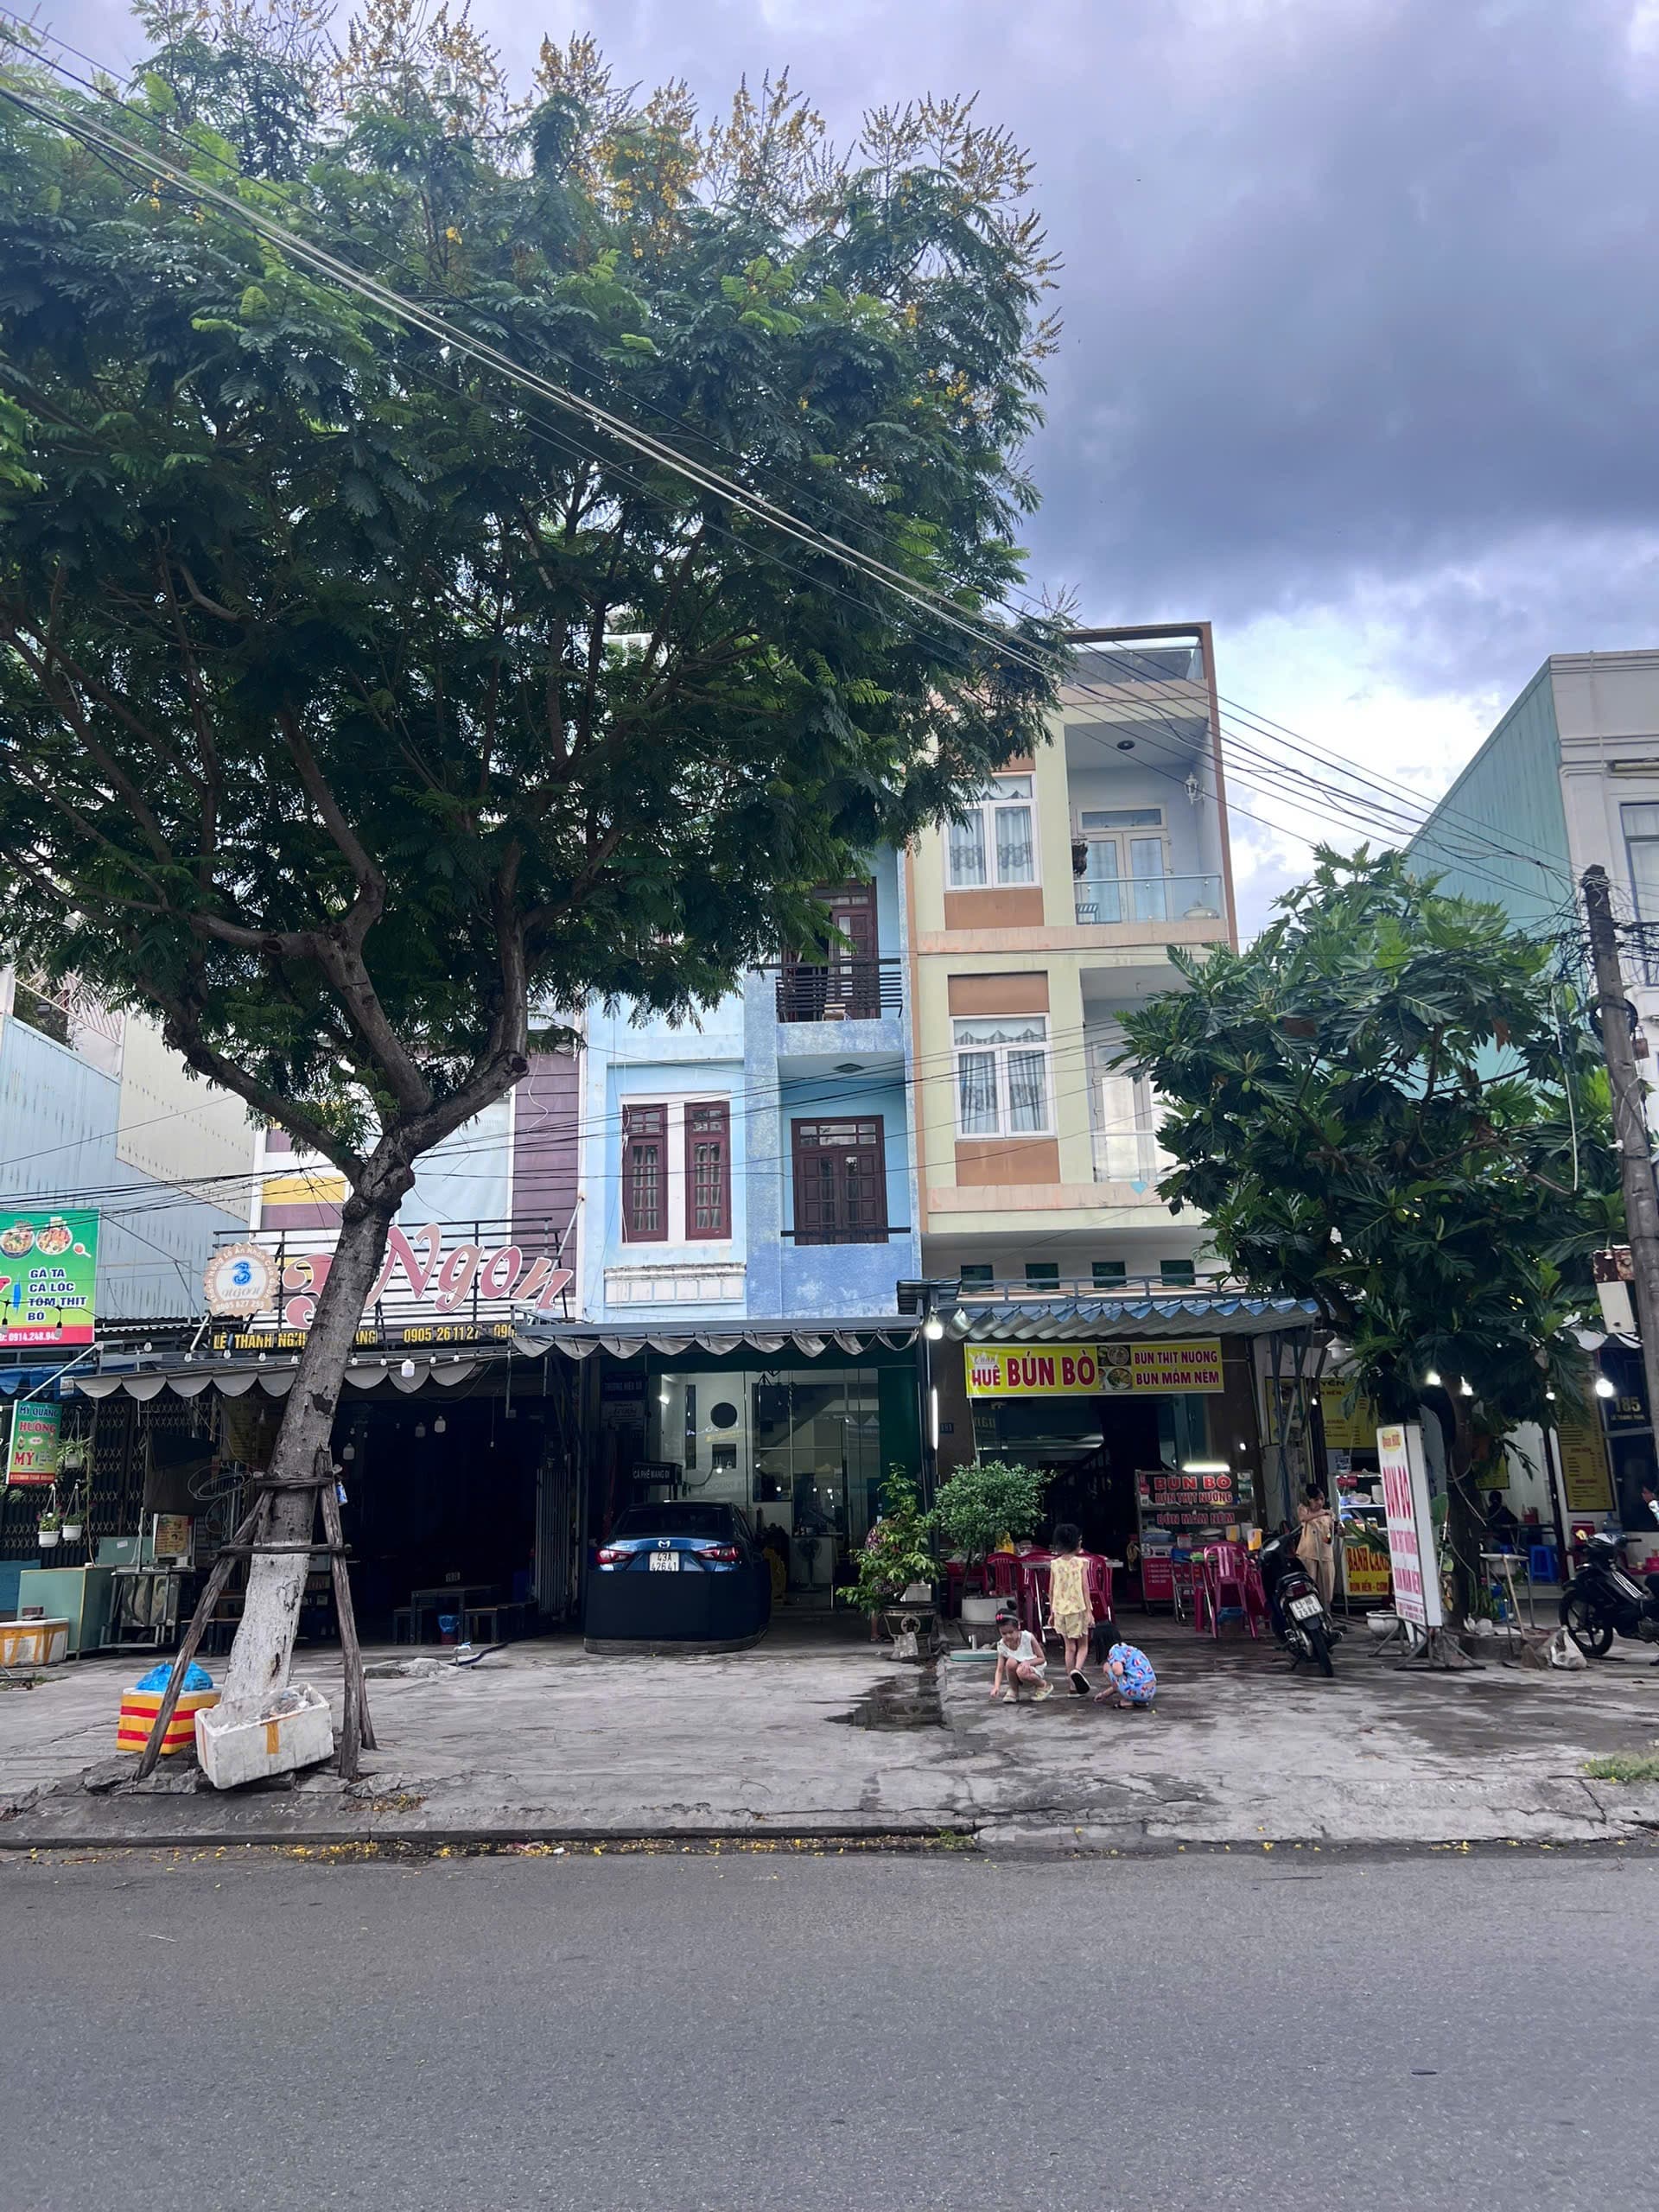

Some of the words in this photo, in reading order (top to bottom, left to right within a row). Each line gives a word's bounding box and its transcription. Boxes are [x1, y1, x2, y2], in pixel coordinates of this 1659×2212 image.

[51, 1268, 66, 1278] TA
[233, 1261, 251, 1286] 3
[363, 1223, 574, 1313] Ngon
[9, 1332, 60, 1342] 0914.248.94
[234, 1333, 274, 1349] THANH
[403, 1327, 432, 1343] 0905
[1007, 1351, 1056, 1387] BÚN
[1062, 1349, 1096, 1386] BÒ
[1154, 1474, 1198, 1491] BÚN
[1202, 1472, 1232, 1490] BÒ
[657, 1551, 672, 1562] 43A
[651, 1562, 677, 1571] 42641
